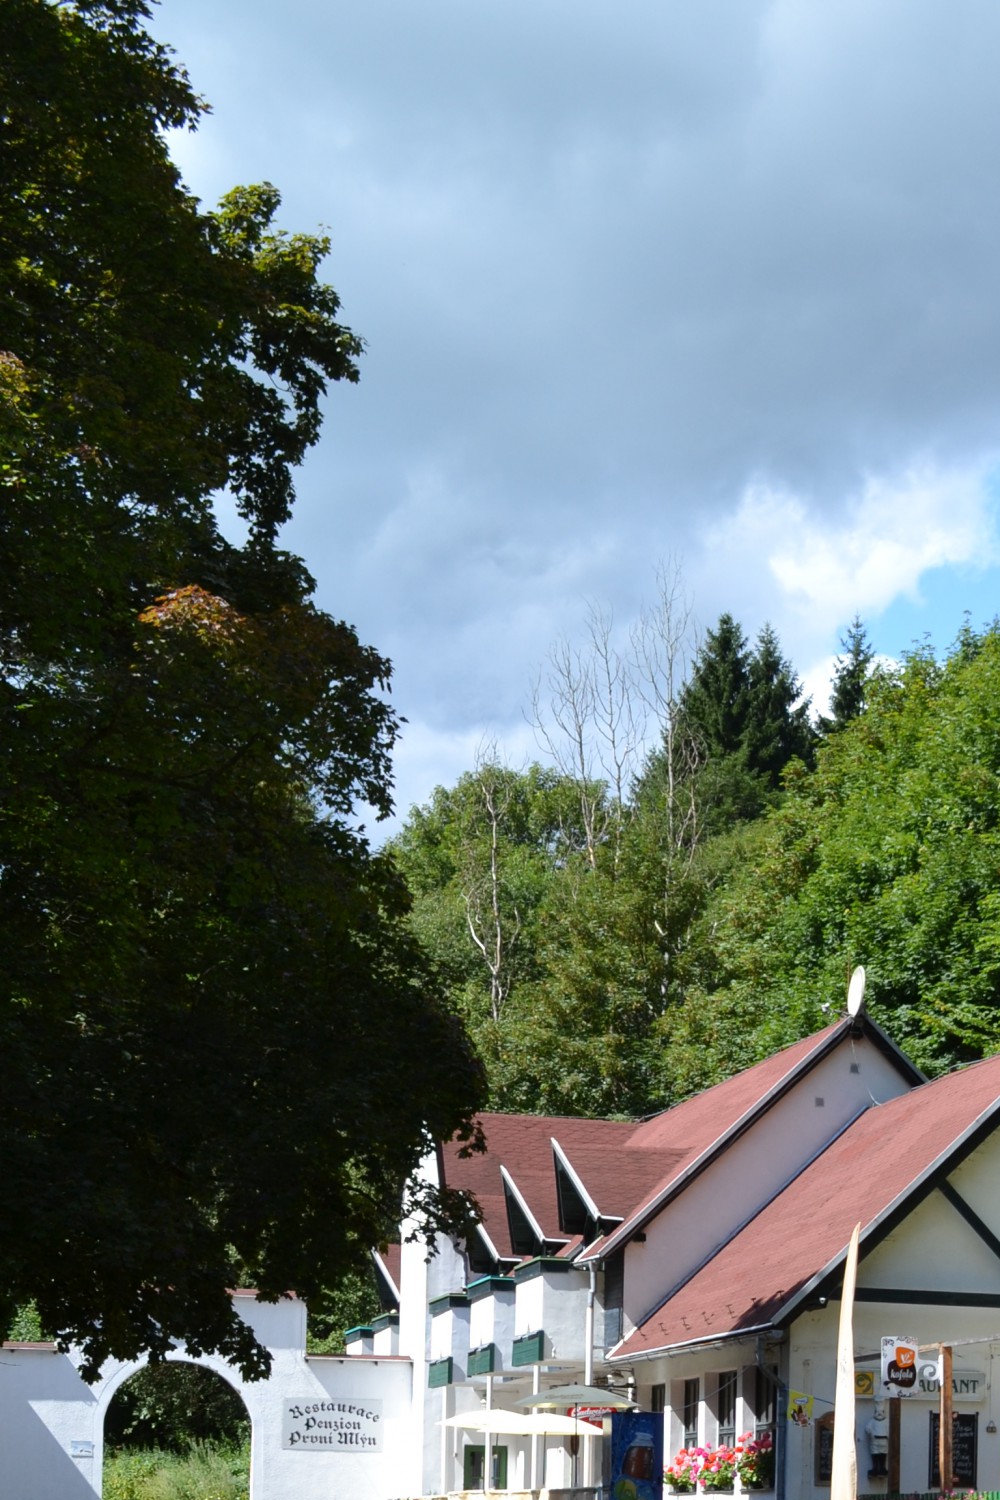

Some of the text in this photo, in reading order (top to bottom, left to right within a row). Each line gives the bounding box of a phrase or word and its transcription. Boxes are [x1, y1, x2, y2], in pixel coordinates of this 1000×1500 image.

[891, 1368, 913, 1380] kofola
[289, 1401, 380, 1422] Restaurace
[304, 1416, 361, 1431] Penzion
[289, 1431, 376, 1448] První Mlýn
